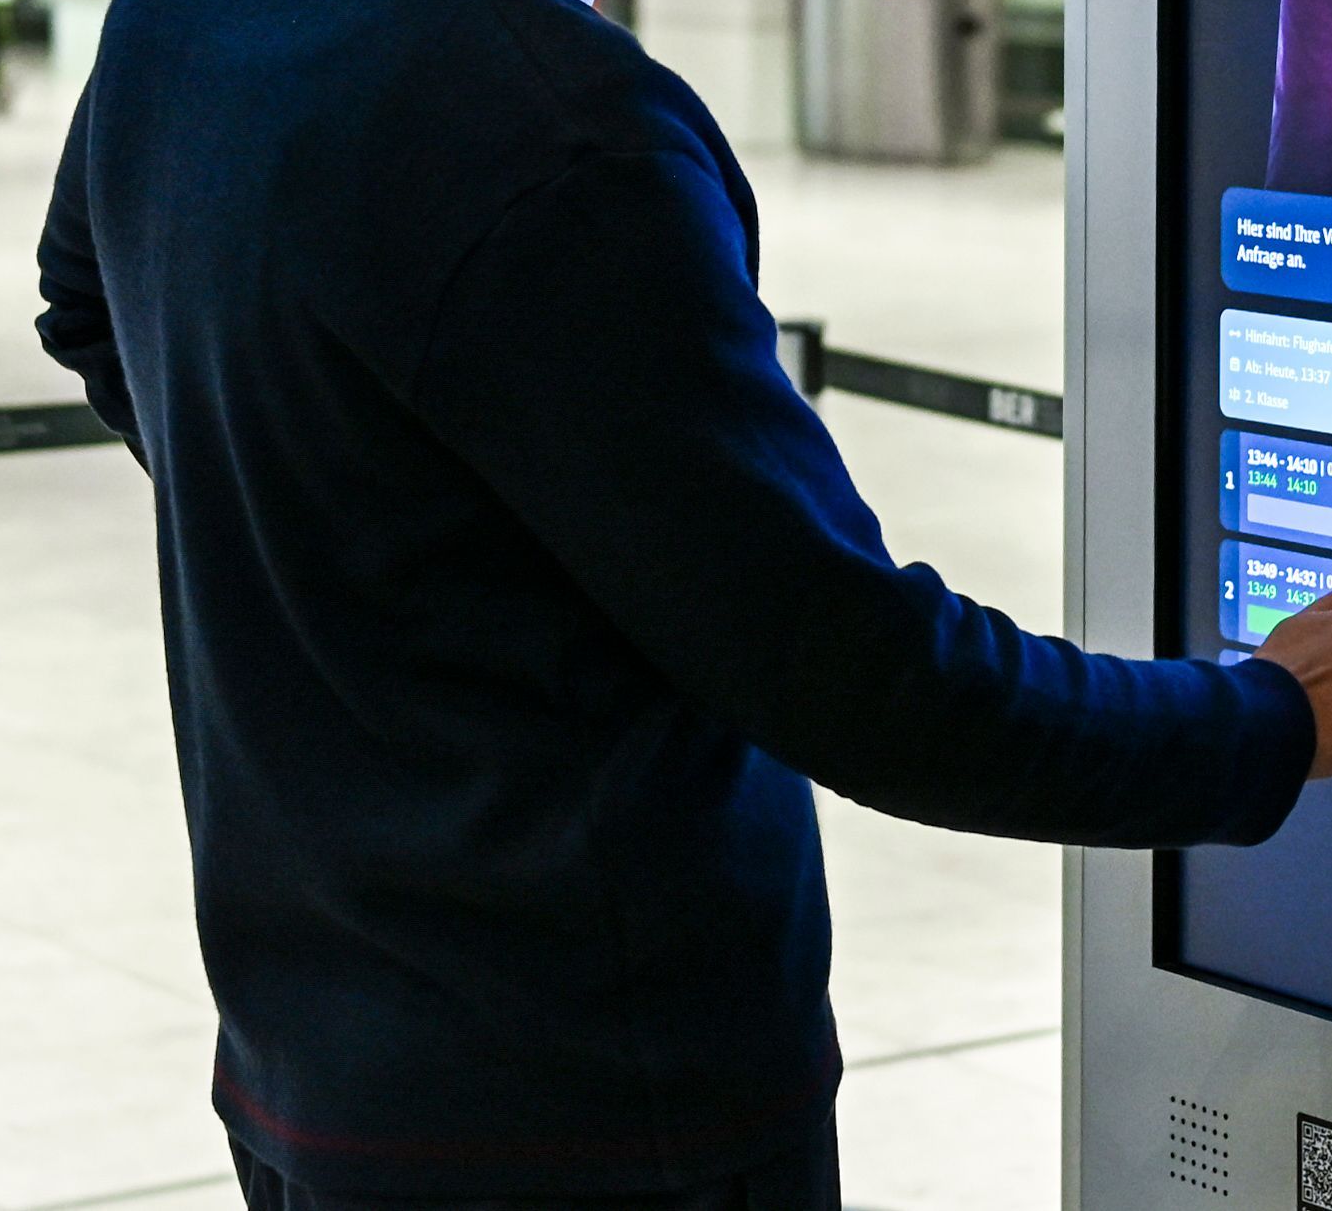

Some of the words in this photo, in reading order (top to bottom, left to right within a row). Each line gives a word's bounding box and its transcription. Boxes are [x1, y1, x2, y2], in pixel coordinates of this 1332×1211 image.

[1237, 218, 1263, 237] Hier
[1266, 222, 1291, 241] sind
[1294, 224, 1320, 244] Ihre
[1237, 244, 1284, 270] Anfrage
[1286, 253, 1307, 269] an.
[1245, 329, 1290, 348] Hinfahrt:
[1245, 360, 1262, 376] Ab:
[1265, 365, 1298, 383] Heute,
[1301, 367, 1330, 385] 13:37
[1257, 391, 1289, 410] Klasse
[1247, 448, 1278, 469] 13:44
[1287, 455, 1318, 476] 14:10
[1225, 471, 1235, 490] 1
[1248, 470, 1277, 489] 13:44
[1287, 477, 1317, 496] 14:10
[1247, 559, 1278, 580] 13:49
[1286, 566, 1317, 588] 14:32
[1224, 580, 1234, 600] 2
[1247, 580, 1277, 599] 13:49
